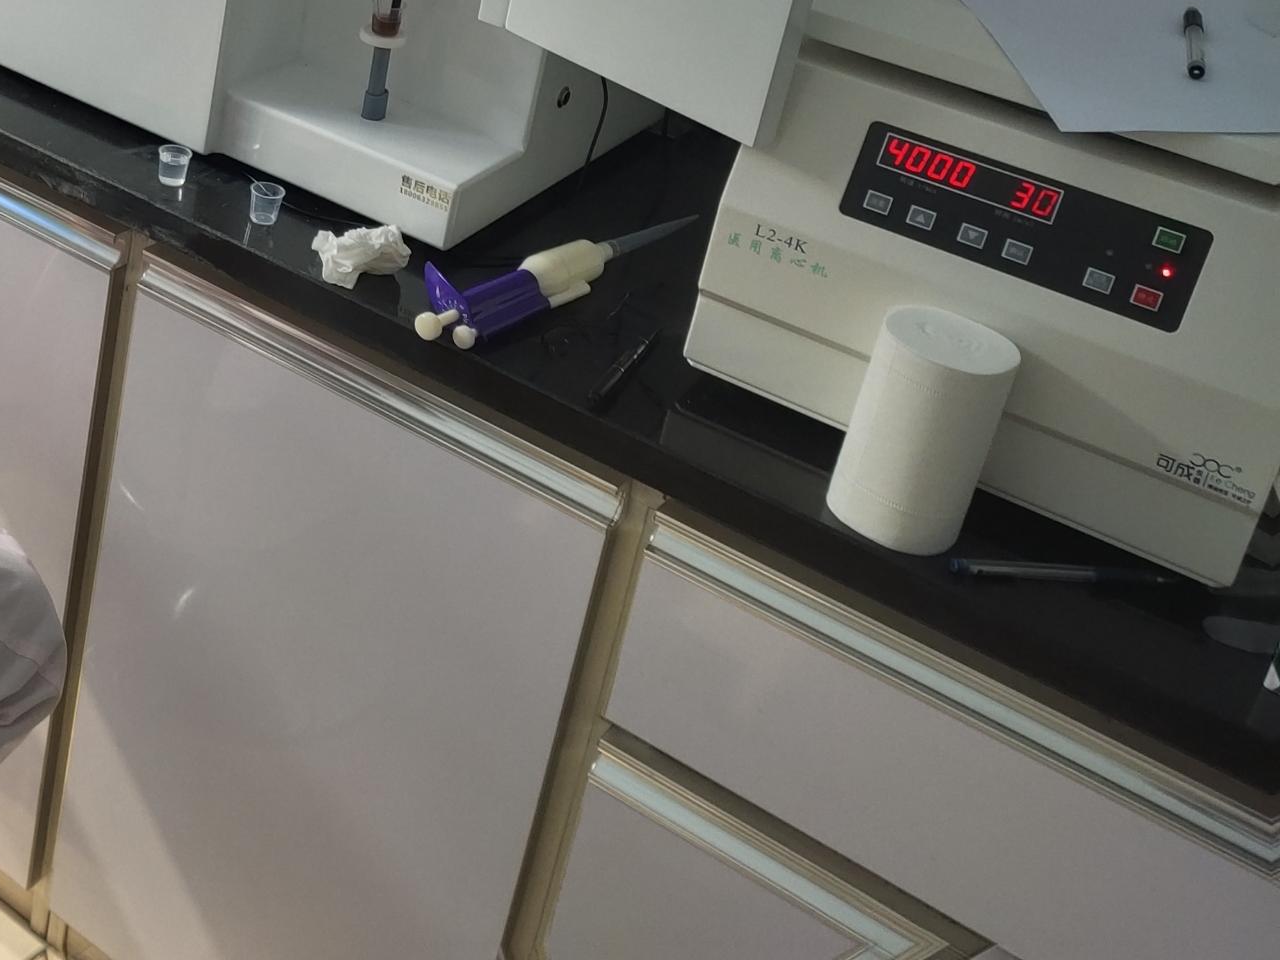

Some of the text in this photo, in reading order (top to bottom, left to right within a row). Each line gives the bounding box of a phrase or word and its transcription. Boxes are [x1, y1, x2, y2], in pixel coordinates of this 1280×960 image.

[401, 175, 449, 205] 售后电话
[888, 139, 976, 188] 4000
[1009, 181, 1060, 218] 30
[755, 224, 808, 254] L2-4K
